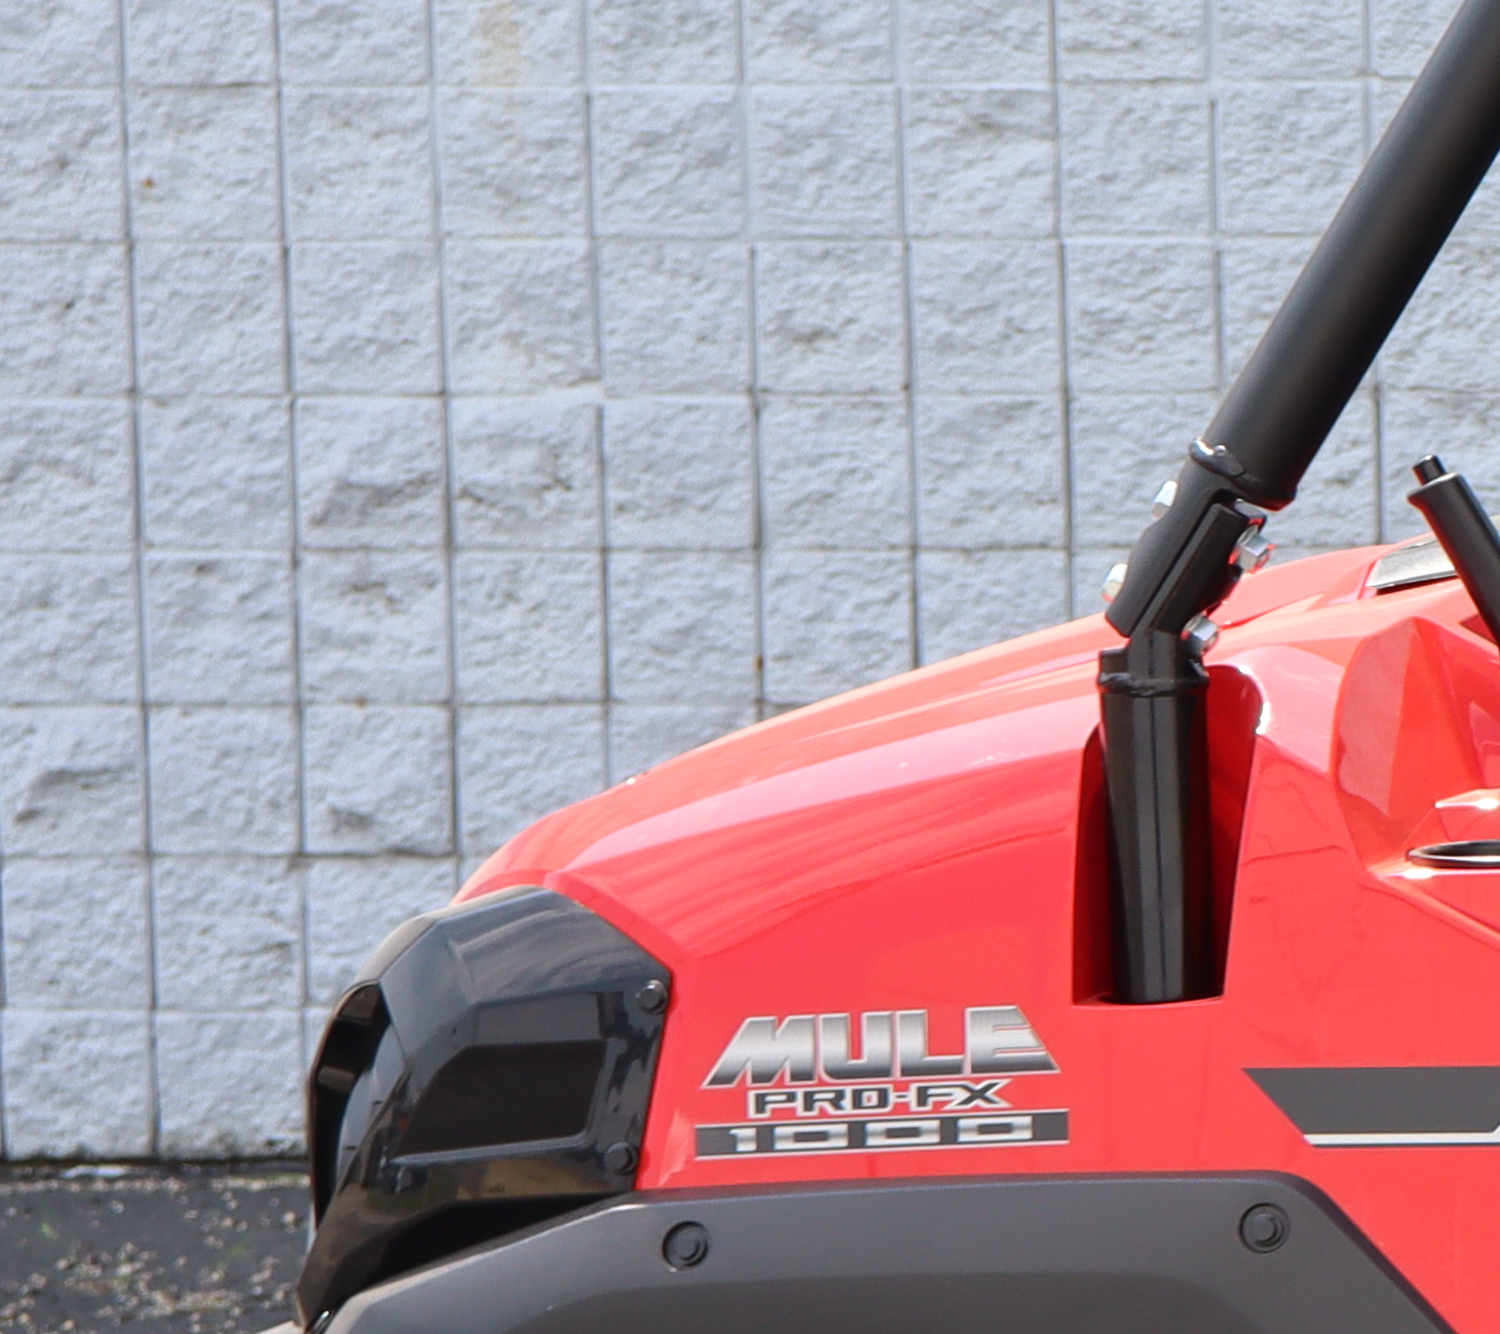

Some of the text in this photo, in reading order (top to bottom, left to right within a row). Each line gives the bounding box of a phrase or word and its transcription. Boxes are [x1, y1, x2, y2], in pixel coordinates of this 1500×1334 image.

[701, 1005, 1061, 1088] MULE
[747, 1078, 1012, 1118] PRO-FX
[729, 1115, 1033, 1153] 1000
